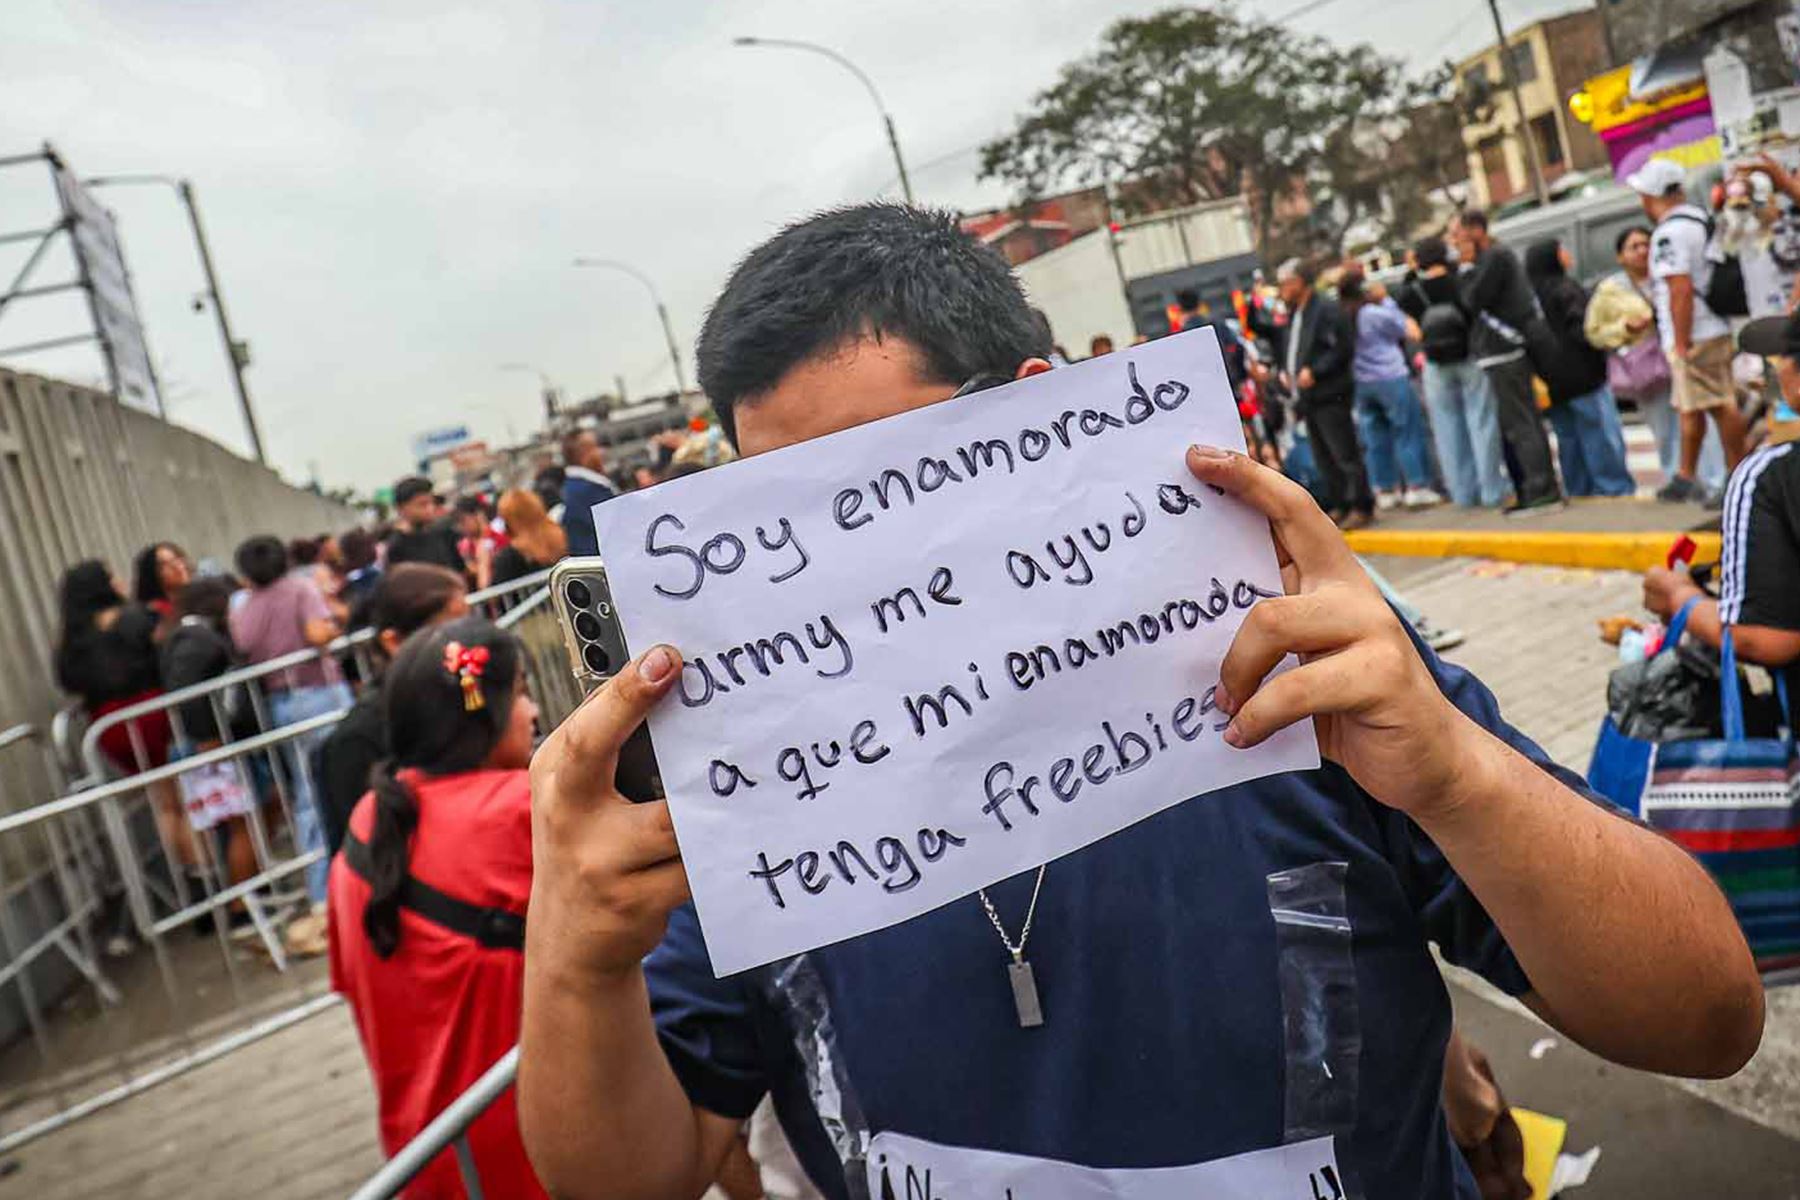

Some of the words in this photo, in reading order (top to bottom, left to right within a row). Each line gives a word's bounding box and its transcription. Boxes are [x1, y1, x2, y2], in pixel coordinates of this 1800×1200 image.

[645, 513, 809, 601] Soy
[833, 361, 1190, 531] enamorado
[680, 614, 854, 708] army
[870, 566, 963, 634] me
[1006, 483, 1225, 589] ayuda
[709, 759, 758, 798] a
[777, 719, 891, 801] que
[903, 660, 991, 737] mi
[1005, 577, 1284, 691] enamorada
[748, 827, 967, 909] tenga
